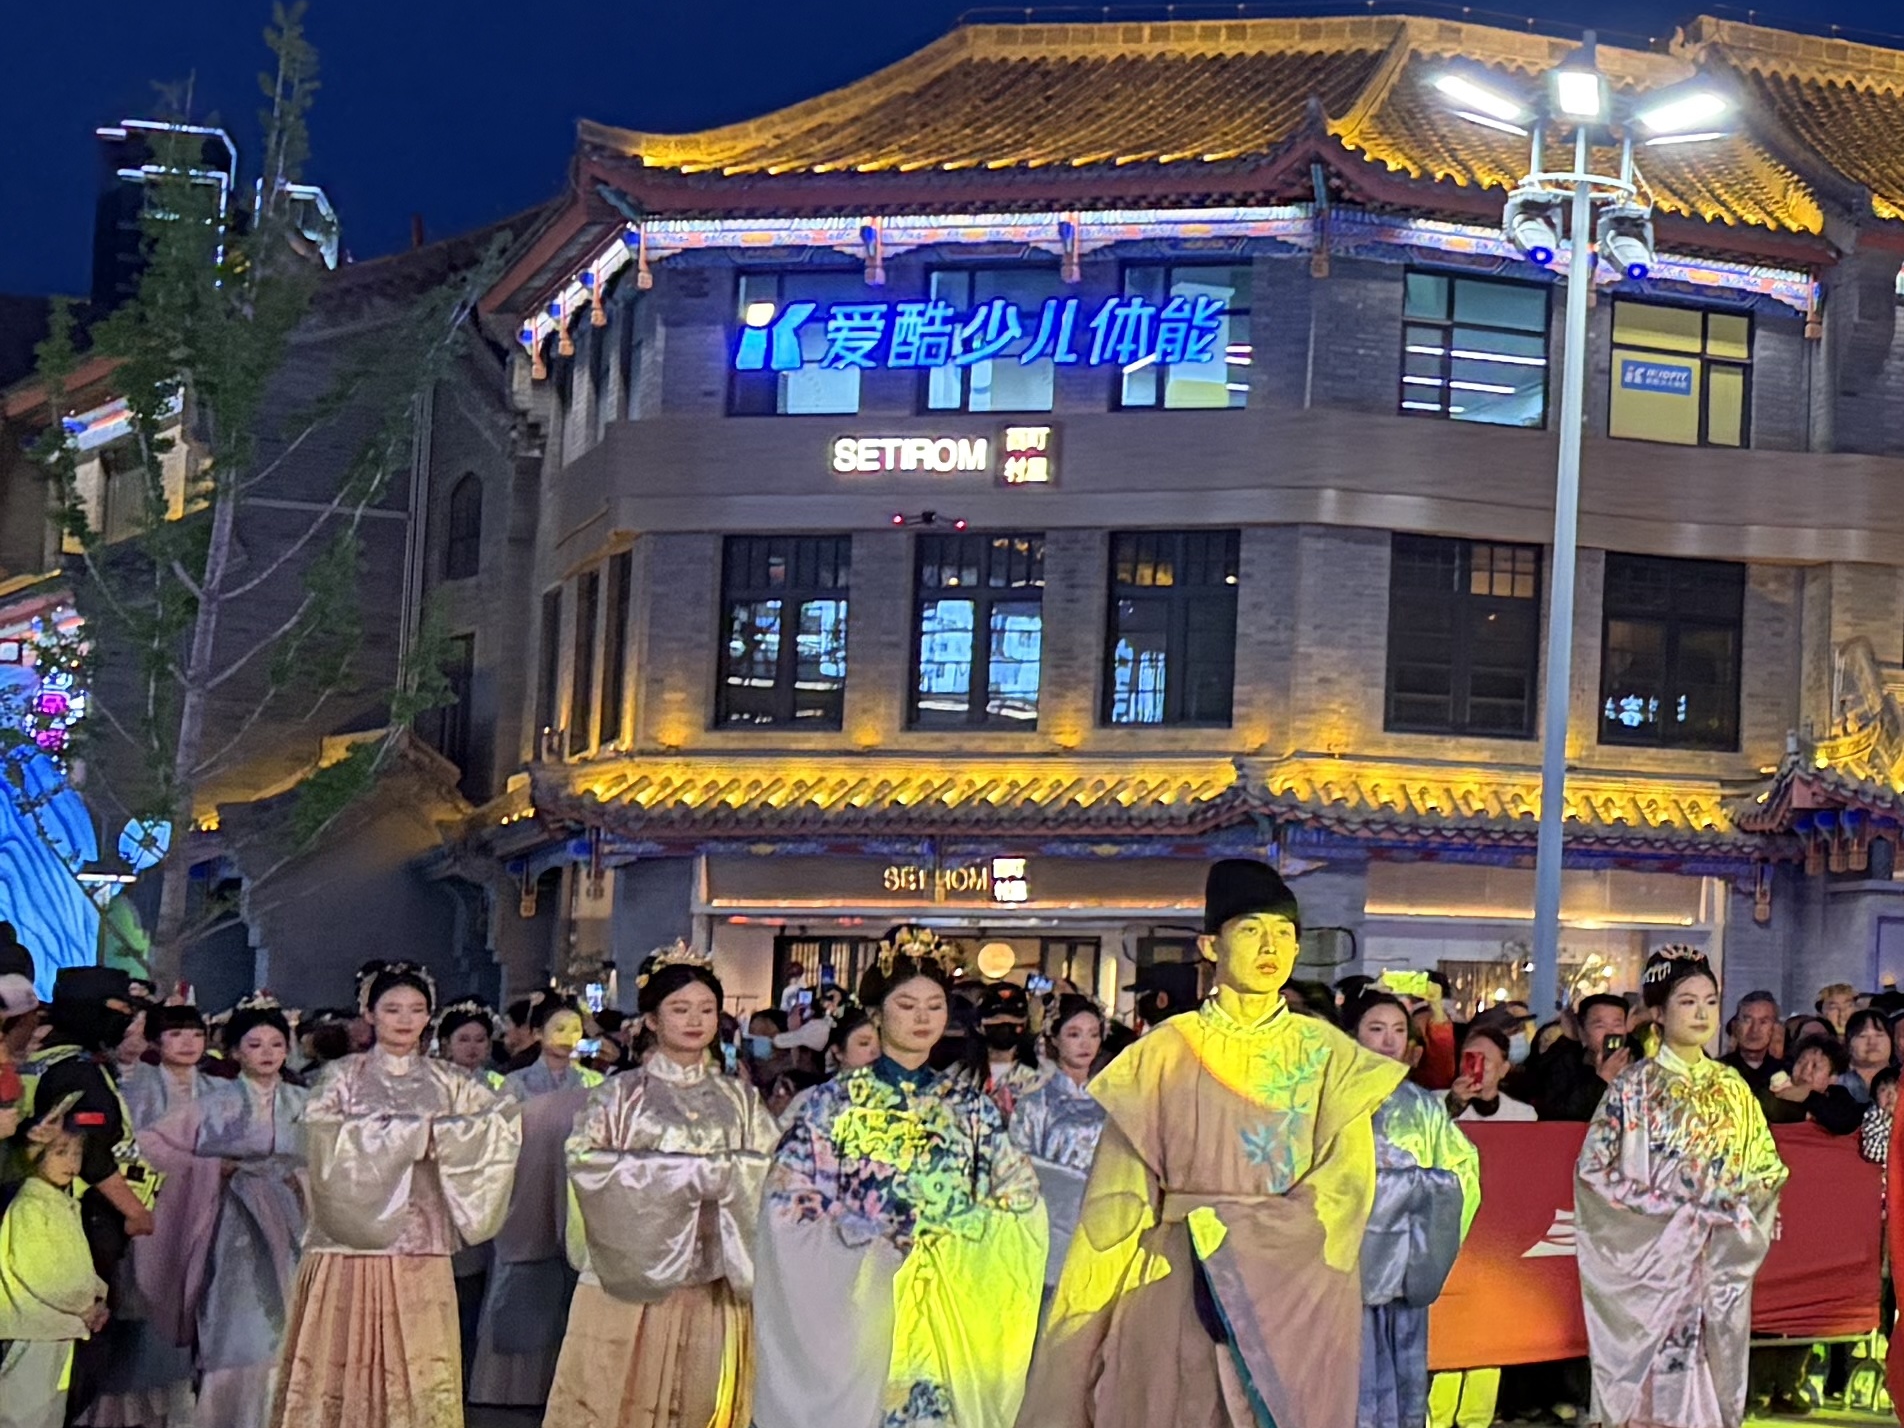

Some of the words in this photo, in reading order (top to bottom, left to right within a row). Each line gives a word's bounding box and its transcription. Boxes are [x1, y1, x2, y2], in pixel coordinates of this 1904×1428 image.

[822, 296, 1228, 368] 爱酷少儿体能
[834, 438, 988, 472] SETIROM
